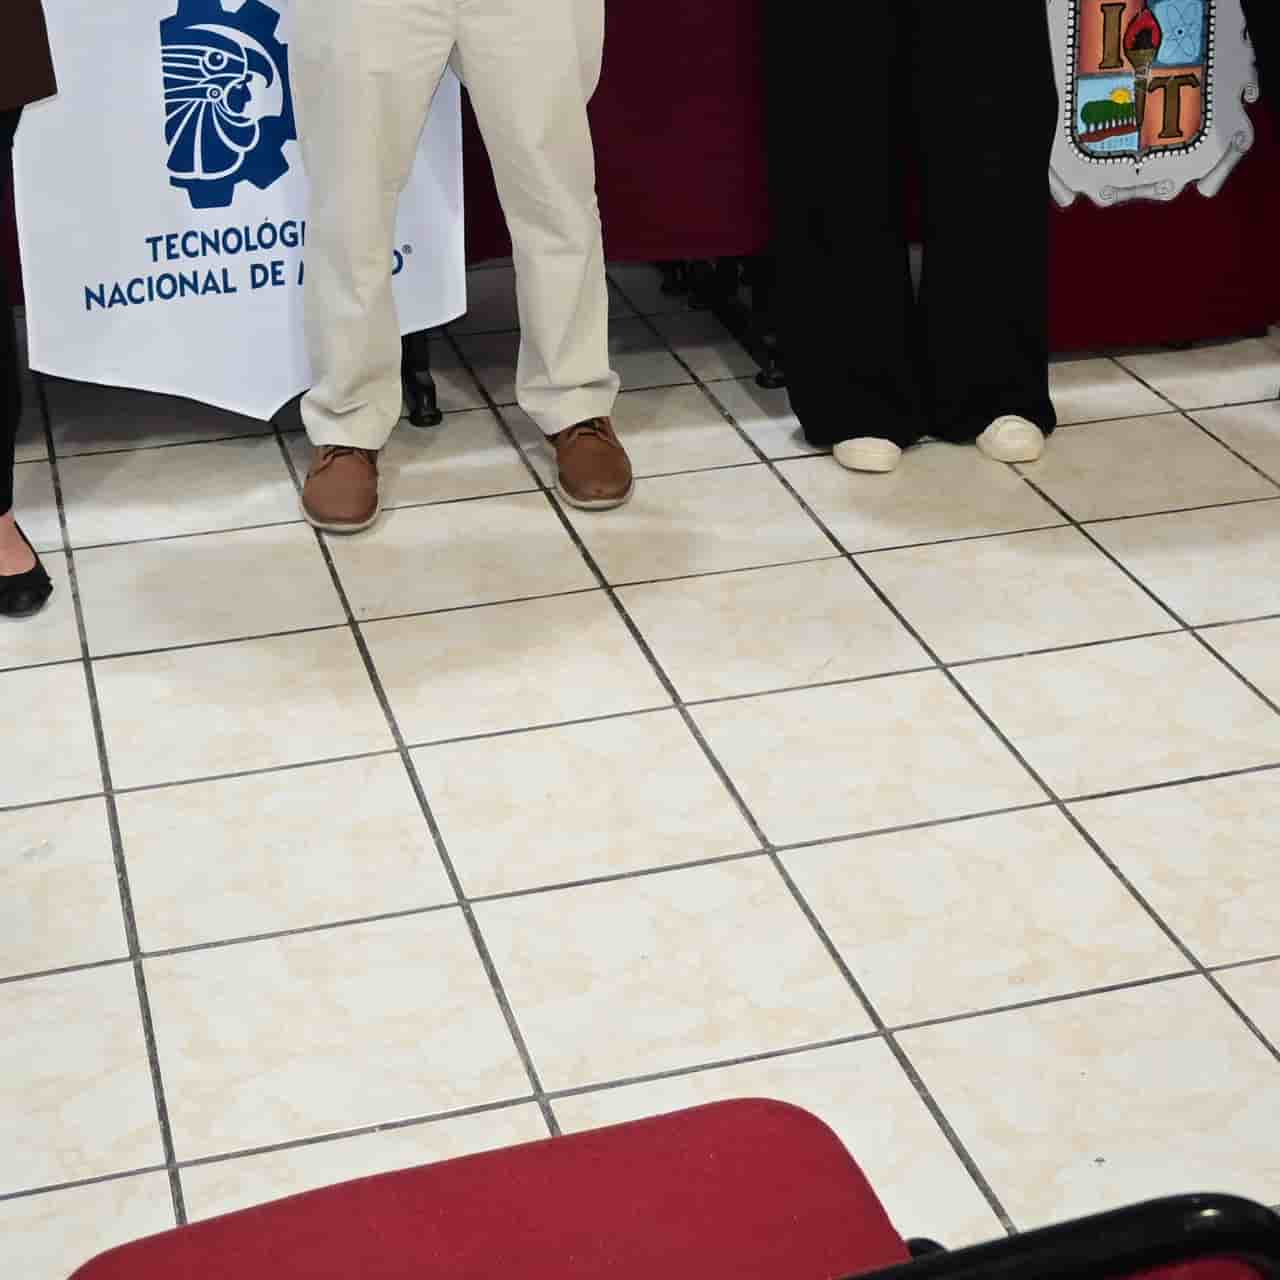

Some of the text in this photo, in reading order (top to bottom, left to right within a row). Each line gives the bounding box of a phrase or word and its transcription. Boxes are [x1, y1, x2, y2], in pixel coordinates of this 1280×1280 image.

[145, 216, 305, 262] TECNOLÓGI
[84, 267, 237, 311] NACIONAL
[250, 260, 285, 289] DE
